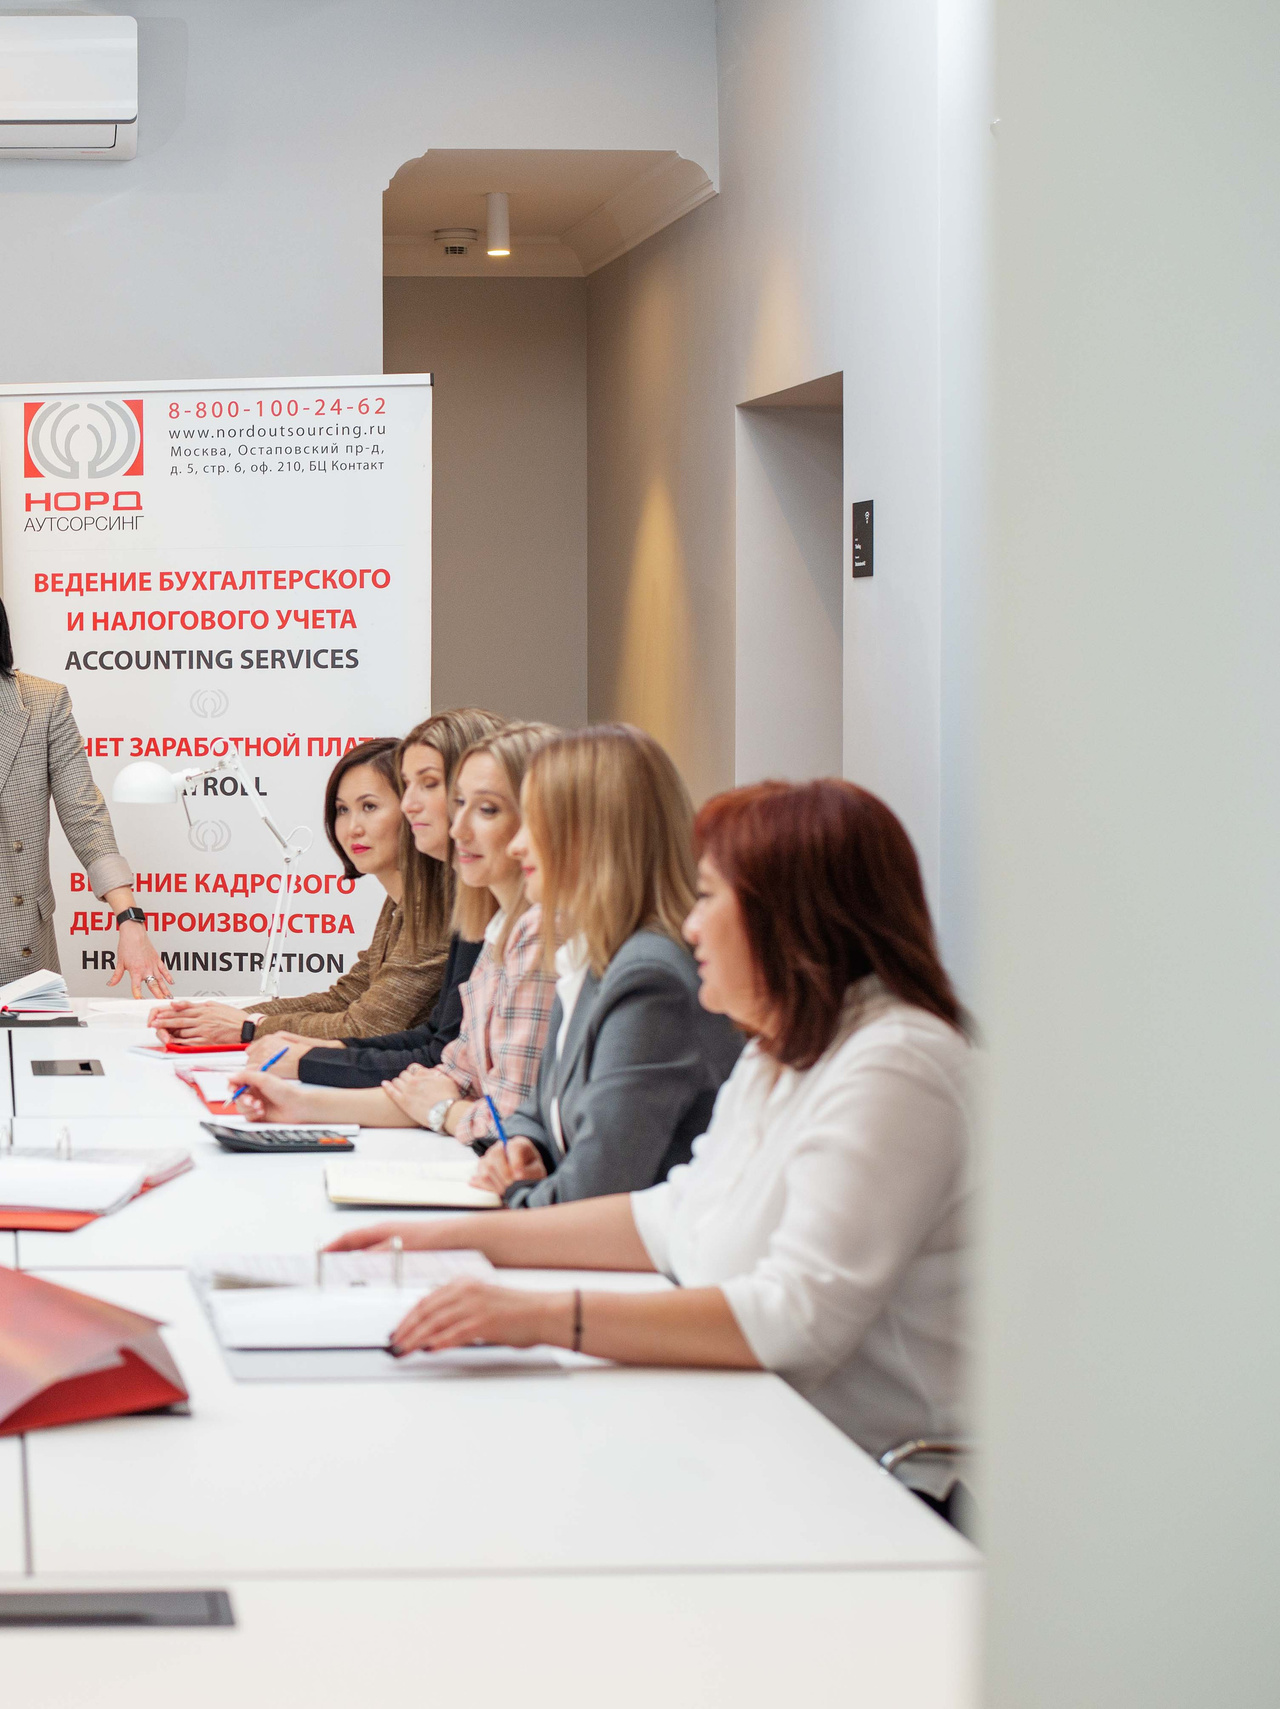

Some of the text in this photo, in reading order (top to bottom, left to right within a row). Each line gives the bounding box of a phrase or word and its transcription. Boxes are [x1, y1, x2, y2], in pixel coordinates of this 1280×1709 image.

[168, 397, 386, 419] 8-800-100-24-62
[168, 423, 386, 439] www.nordoutsourcing.ru
[170, 442, 385, 458] Москва, Остаповский пр-д,
[170, 459, 385, 476] д. 5, стр. 6, оф. 210, БЦ Контакт
[24, 490, 143, 512] НОРД
[23, 515, 145, 533] АУТСОРСИНГ
[34, 568, 391, 596] ВЕДЕНИЕ БУХГАЛТЕРСКОГО
[67, 608, 358, 632] И НАЛОГОВОГО УЧЕТА
[64, 648, 360, 671] ACCOUNTING SERVICES
[84, 732, 380, 757] ЧЕТ ЗАРАБОТНОЙ ПЛА
[70, 872, 356, 898] ВНИЕ КАДРОВОГО
[70, 911, 356, 938] ДЕЛПРОИЗВОДСТВА
[82, 950, 344, 973] HR MINISTRATION
